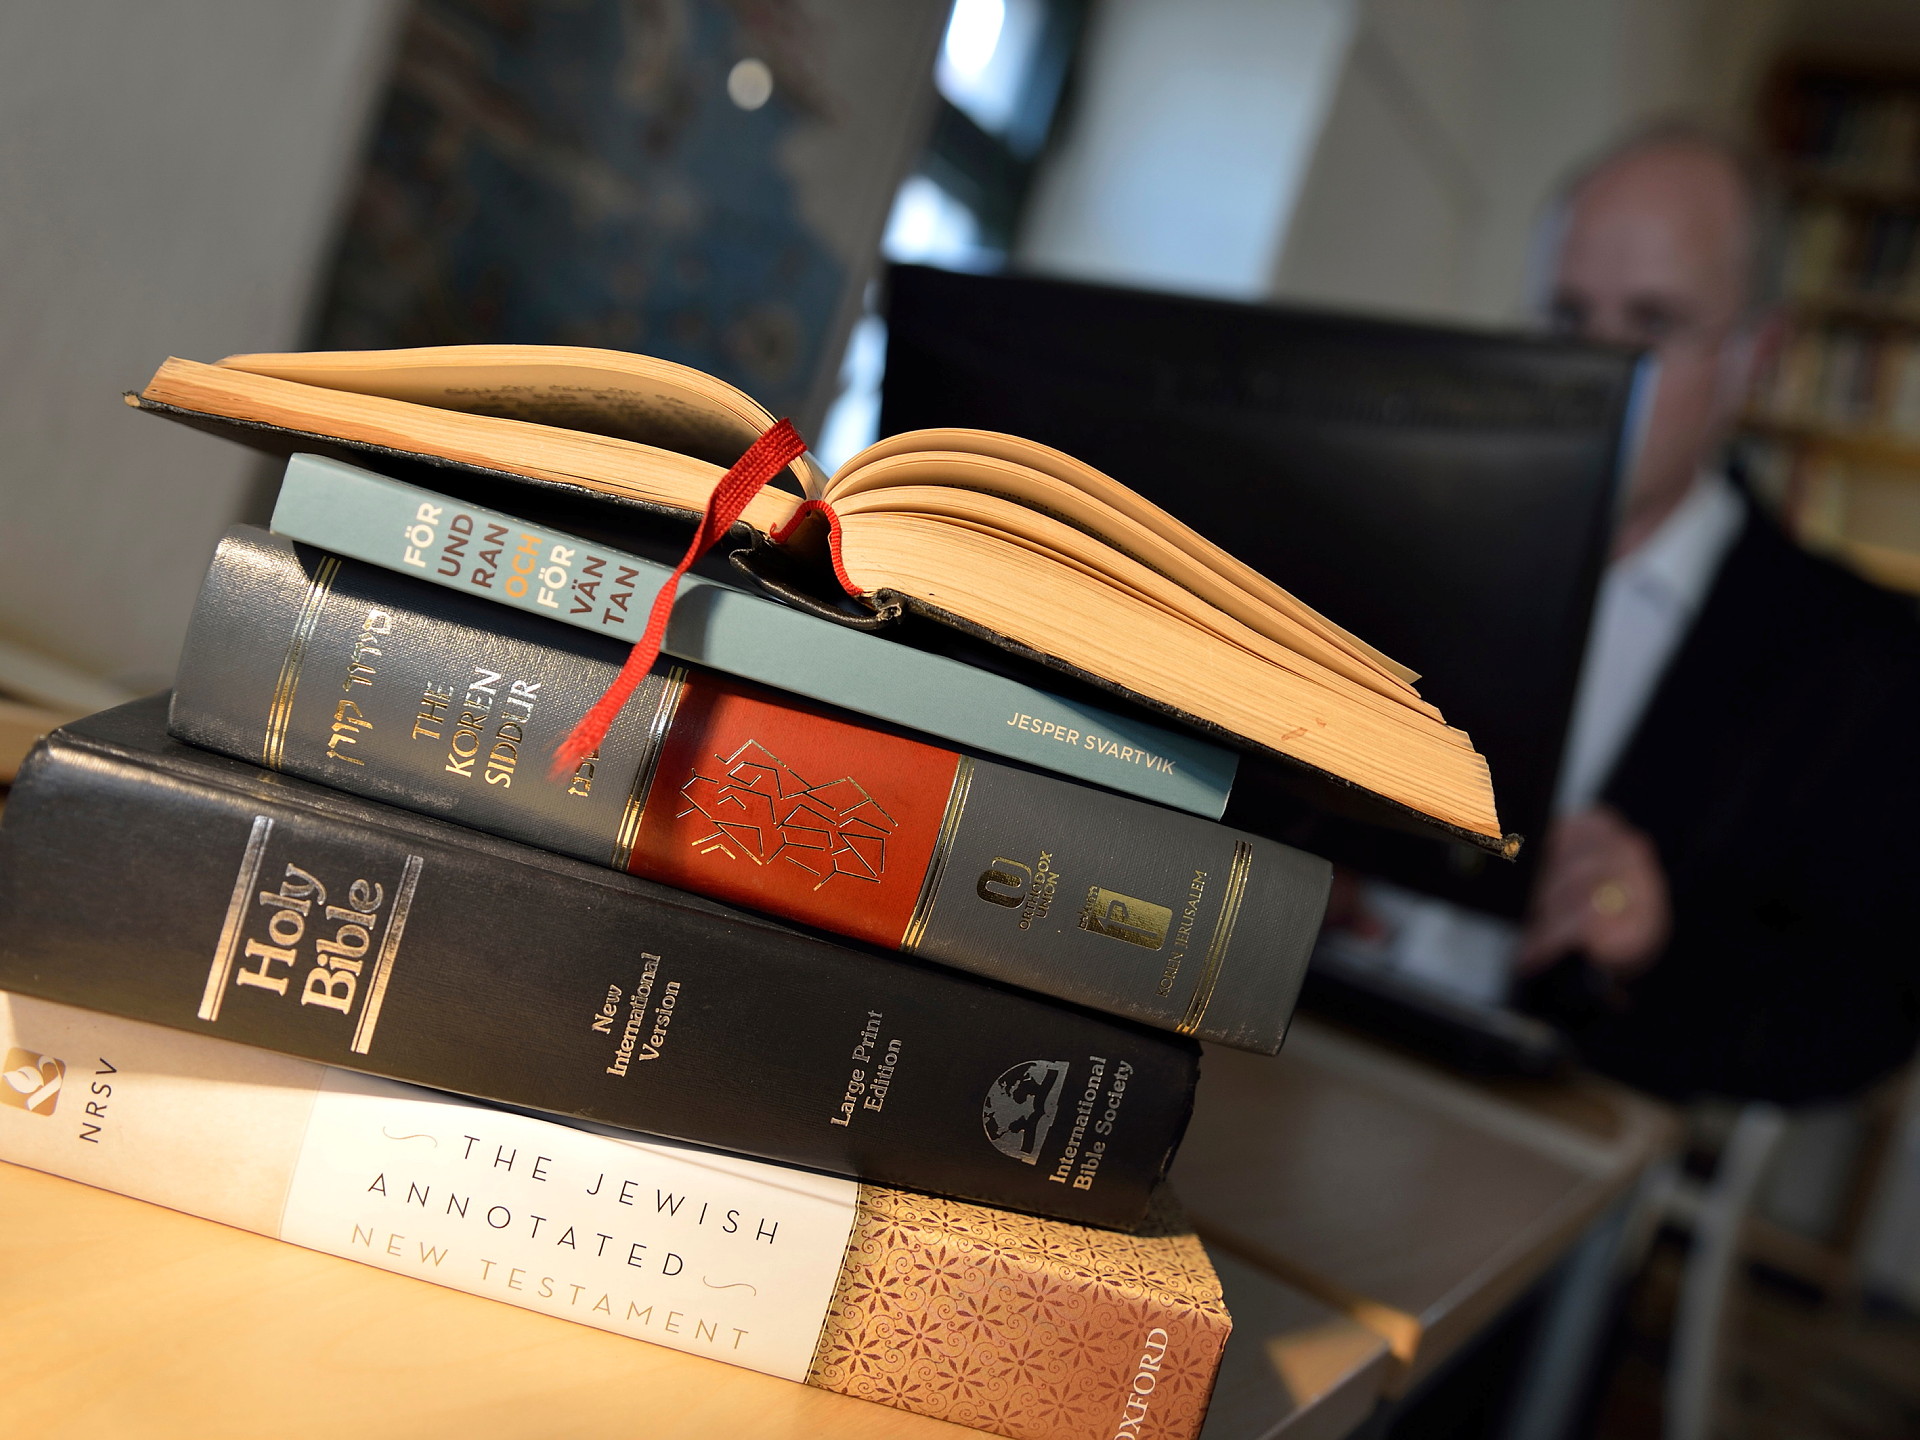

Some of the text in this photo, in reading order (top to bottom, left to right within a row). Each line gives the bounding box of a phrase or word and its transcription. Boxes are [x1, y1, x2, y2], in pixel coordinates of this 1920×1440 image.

[403, 502, 443, 569] FÖR
[437, 514, 474, 577] UND
[470, 523, 509, 588] RAN
[505, 533, 542, 598] OCH
[537, 544, 575, 609] FÖR
[570, 555, 607, 614] VÄN
[602, 565, 640, 625] TAN
[326, 699, 373, 766] קורן
[411, 680, 454, 740] THE
[445, 666, 501, 778] KOREN
[484, 679, 542, 789] SIDDUR
[1006, 712, 1176, 775] JESPER SVARTVIK
[235, 862, 327, 997] Holy
[1018, 850, 1053, 931] ORTHODOX
[1035, 872, 1060, 919] UNION
[301, 878, 384, 1015] Bible
[1155, 869, 1207, 998] KOREN JERUSALEM
[592, 984, 623, 1035] New
[606, 951, 661, 1078] International
[638, 980, 681, 1062] Version
[79, 1057, 117, 1144] NRSV
[830, 1009, 883, 1127] Large Print
[863, 1038, 903, 1113] Edition
[1049, 1055, 1107, 1184] International
[1072, 1060, 1134, 1191] Bible Society
[367, 1172, 684, 1277] ANNOTATED
[463, 1134, 779, 1245] THE JEWISH
[351, 1223, 749, 1350] NEW TESTAMENT
